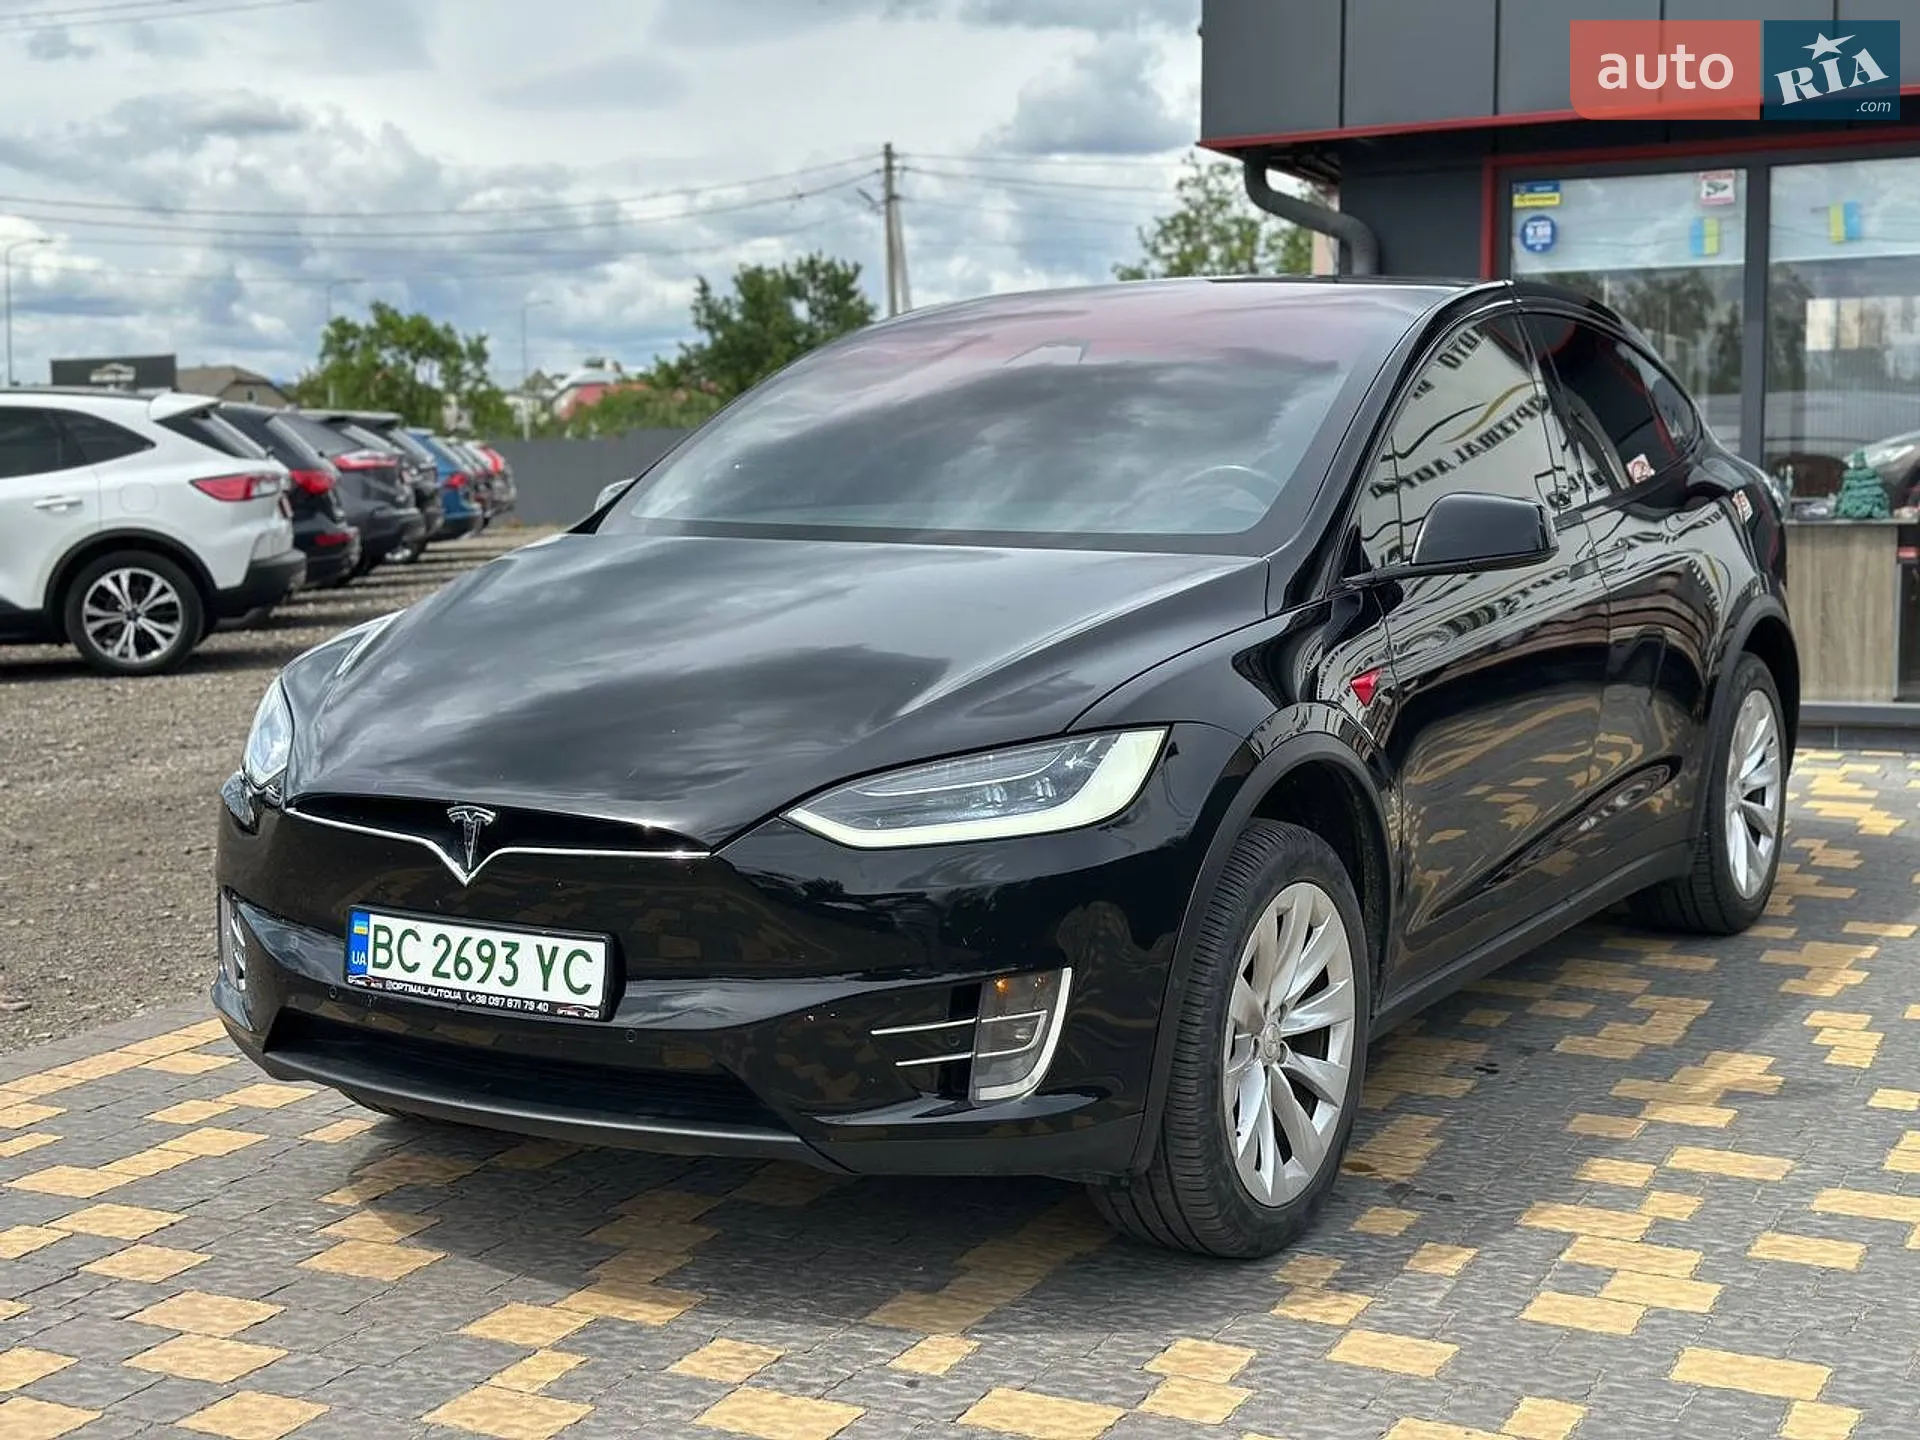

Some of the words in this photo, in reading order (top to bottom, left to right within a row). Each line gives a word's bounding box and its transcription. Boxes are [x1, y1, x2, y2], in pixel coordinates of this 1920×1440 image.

[352, 951, 367, 965] UA
[372, 924, 421, 973] BC
[432, 933, 520, 987] 2693
[536, 944, 593, 995] YC
